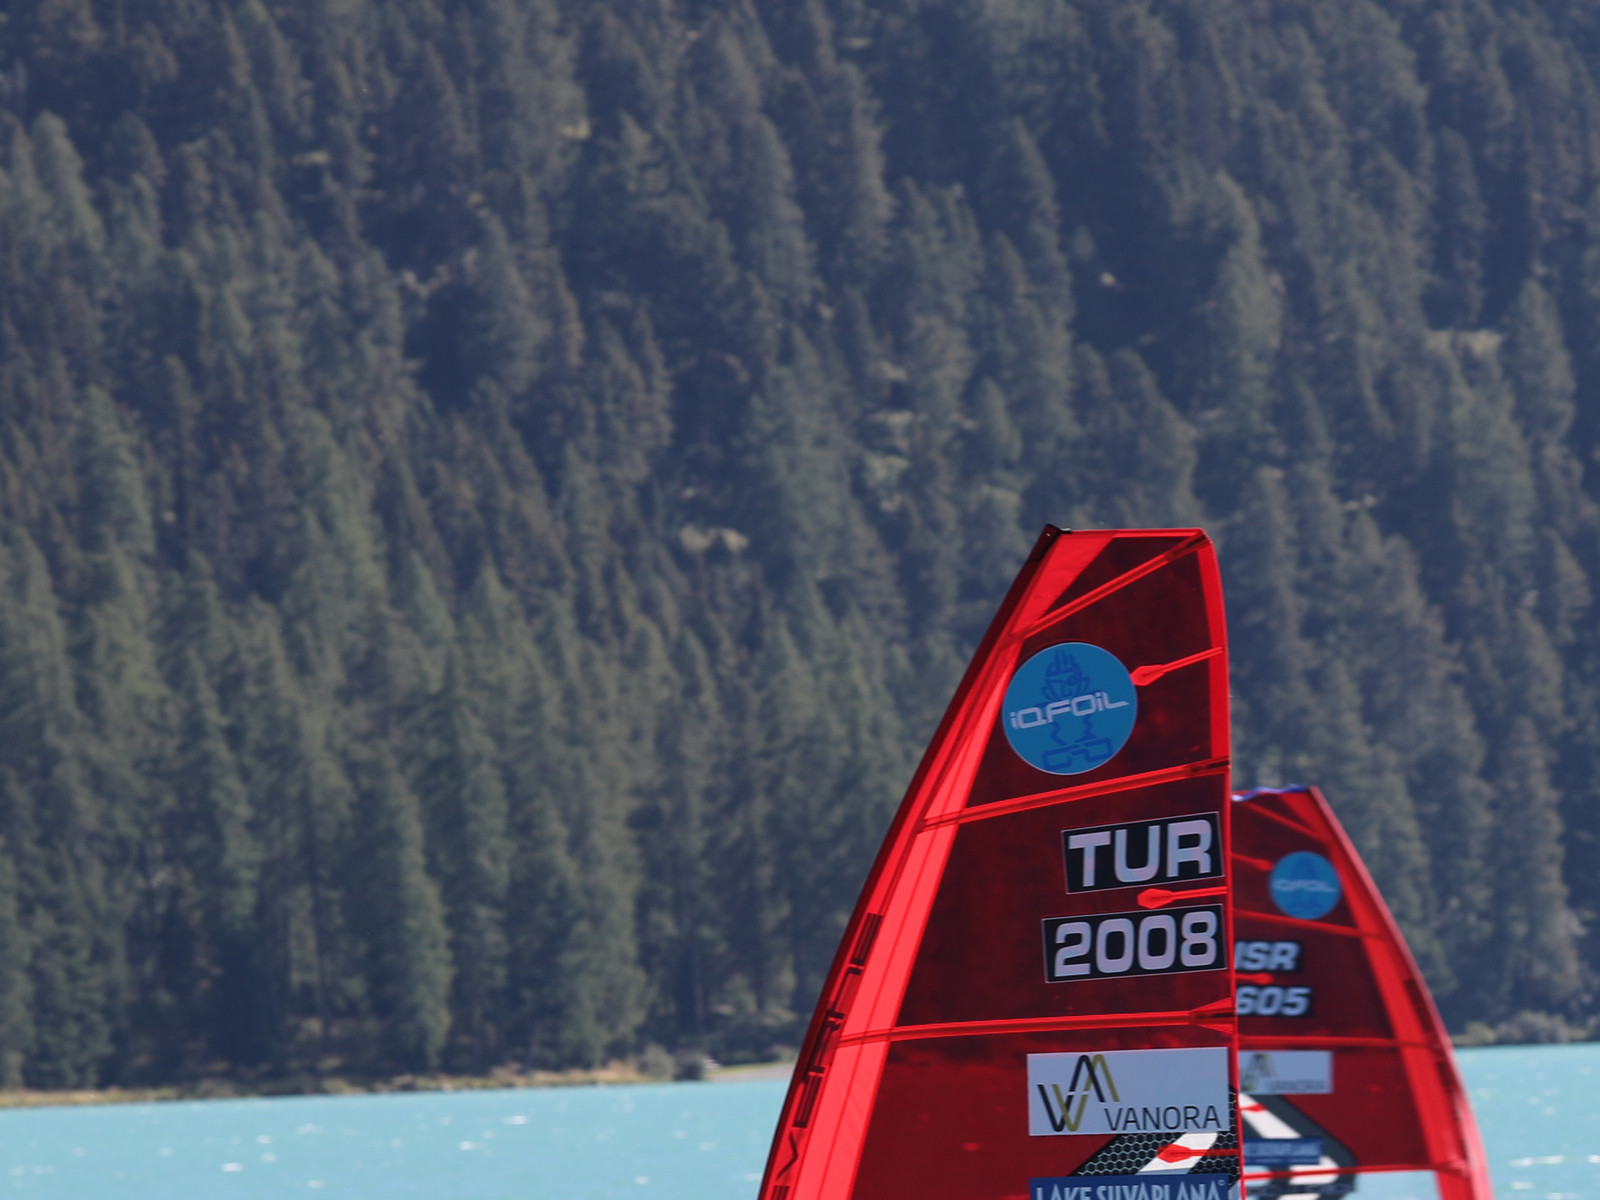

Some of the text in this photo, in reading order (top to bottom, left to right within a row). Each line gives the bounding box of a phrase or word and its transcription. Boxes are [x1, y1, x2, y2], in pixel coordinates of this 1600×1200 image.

[1068, 818, 1213, 887] TUR
[1053, 910, 1218, 978] 2008
[1103, 1105, 1222, 1131] VANORA
